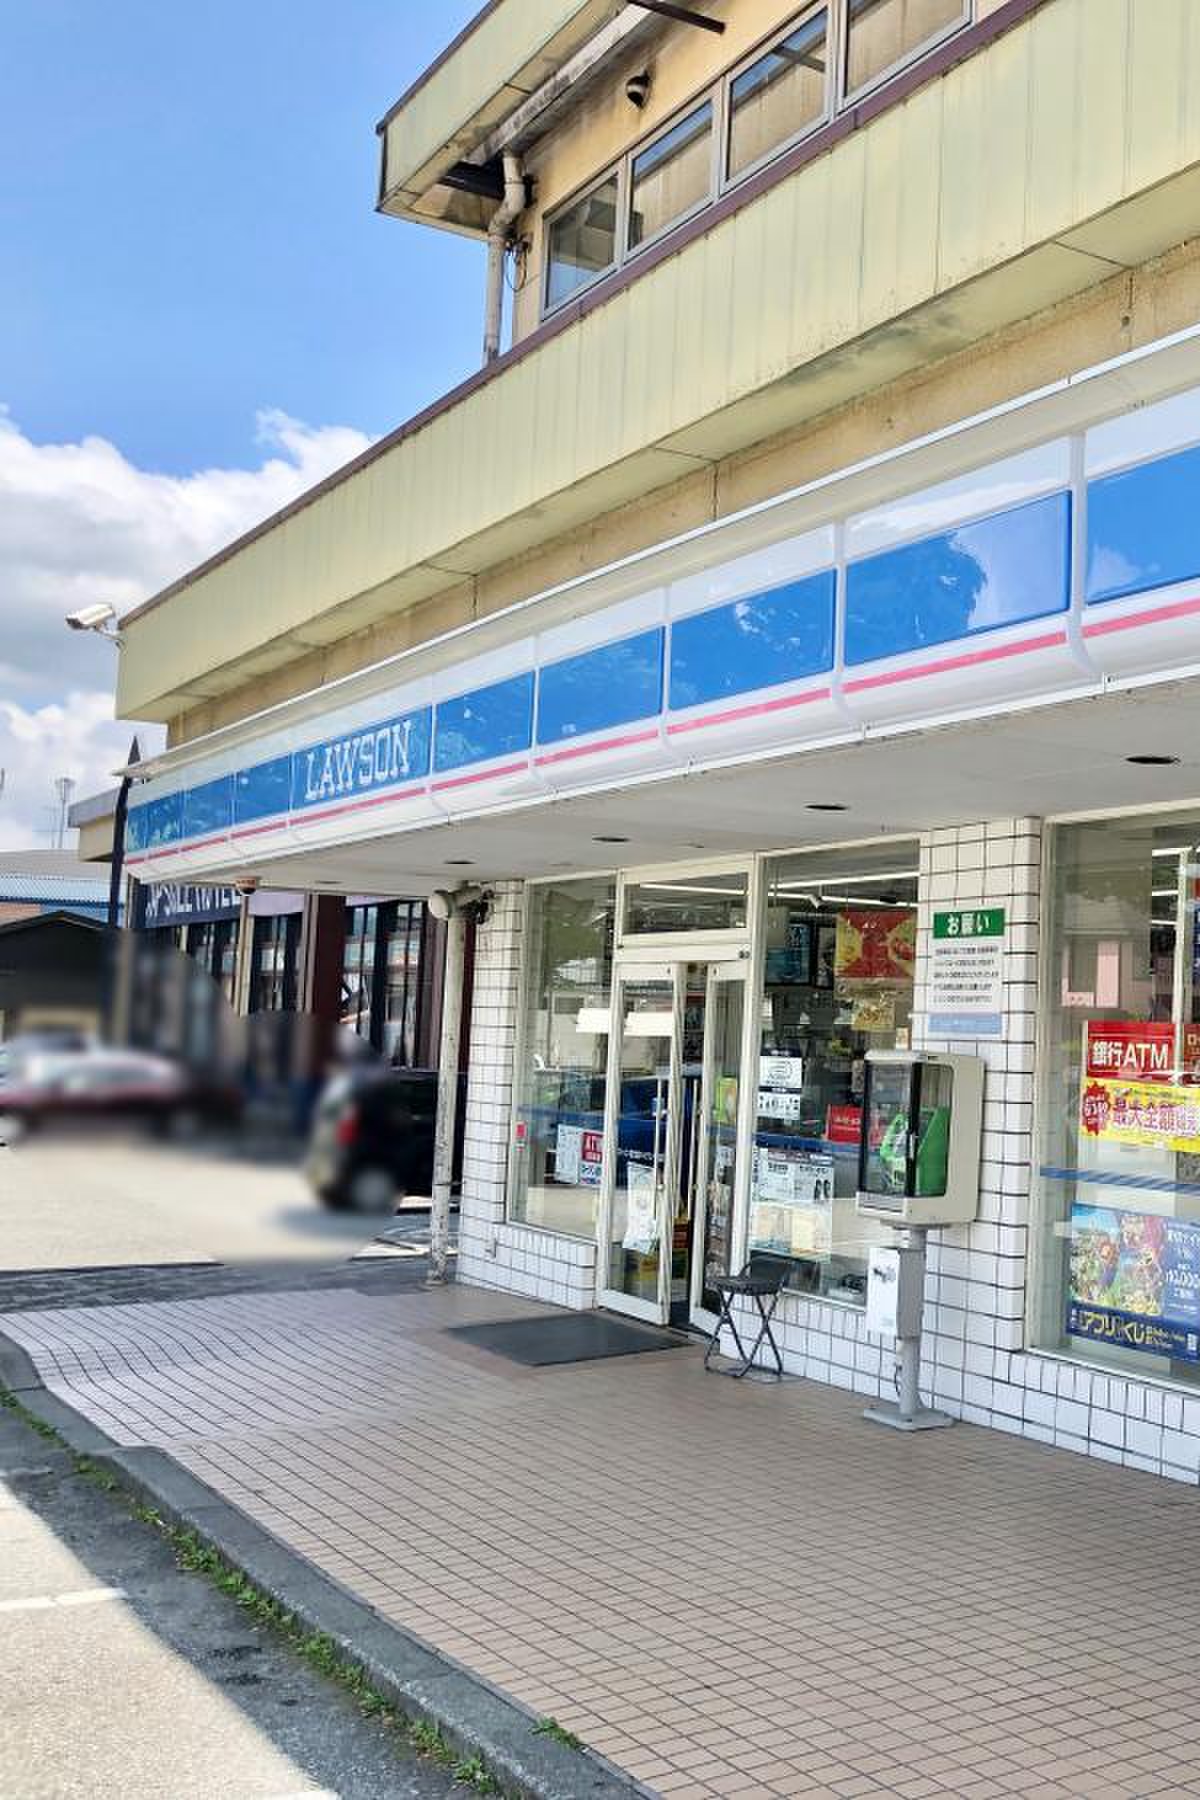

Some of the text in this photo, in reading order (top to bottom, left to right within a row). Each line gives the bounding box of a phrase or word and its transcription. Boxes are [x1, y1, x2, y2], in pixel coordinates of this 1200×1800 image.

[305, 719, 411, 800] LAWSON
[946, 912, 991, 936] お願い
[1092, 1040, 1169, 1069] 銀行ATM
